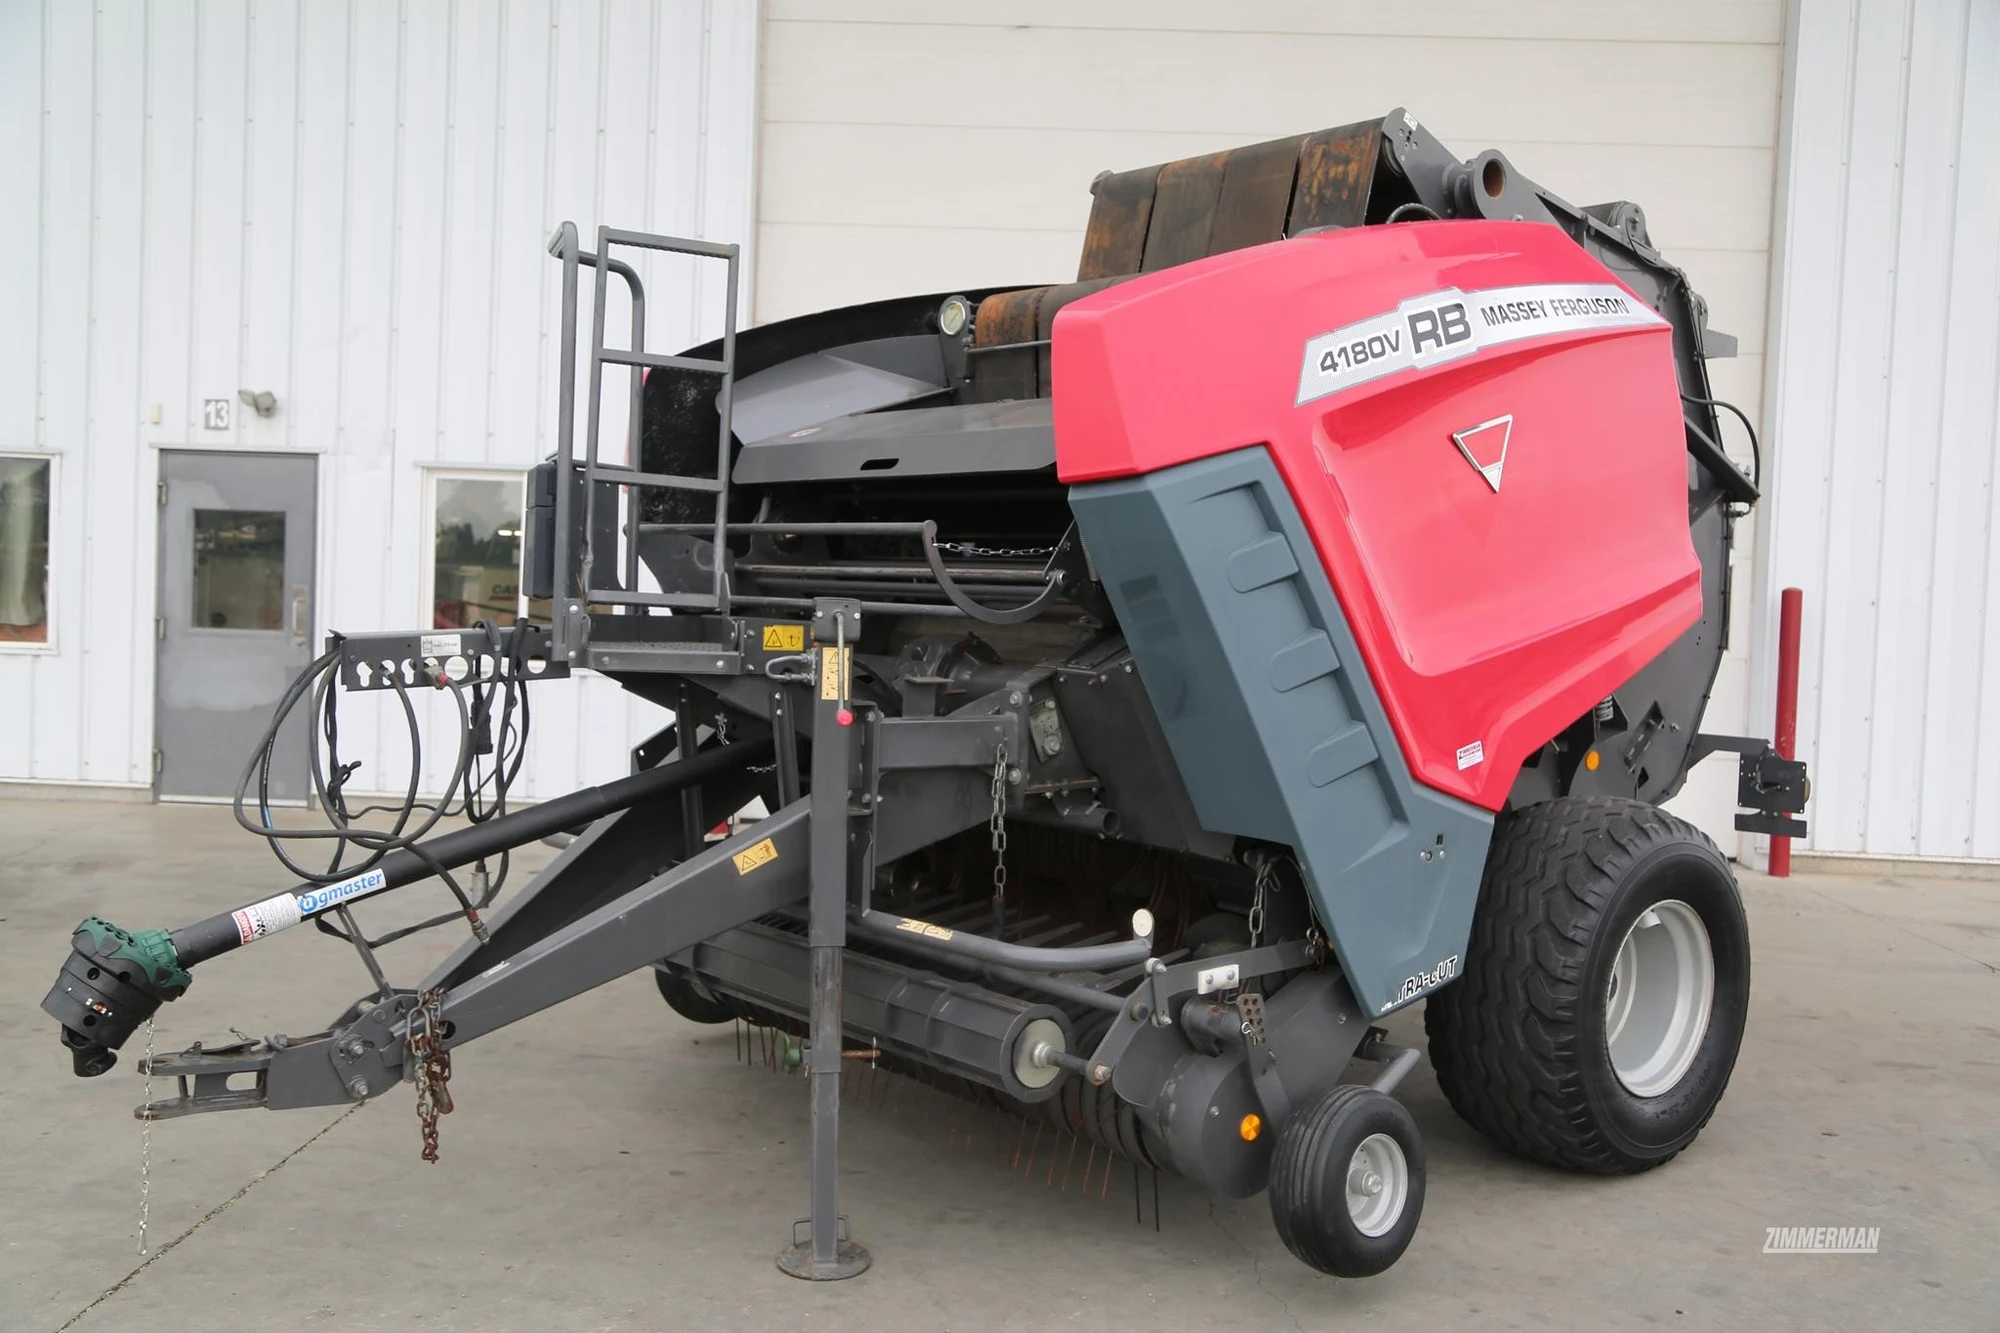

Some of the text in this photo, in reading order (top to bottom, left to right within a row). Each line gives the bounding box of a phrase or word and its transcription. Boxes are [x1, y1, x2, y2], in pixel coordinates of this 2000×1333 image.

[1320, 297, 1631, 373] 4180V RB MASSEY FERGUSON
[205, 400, 229, 428] 13
